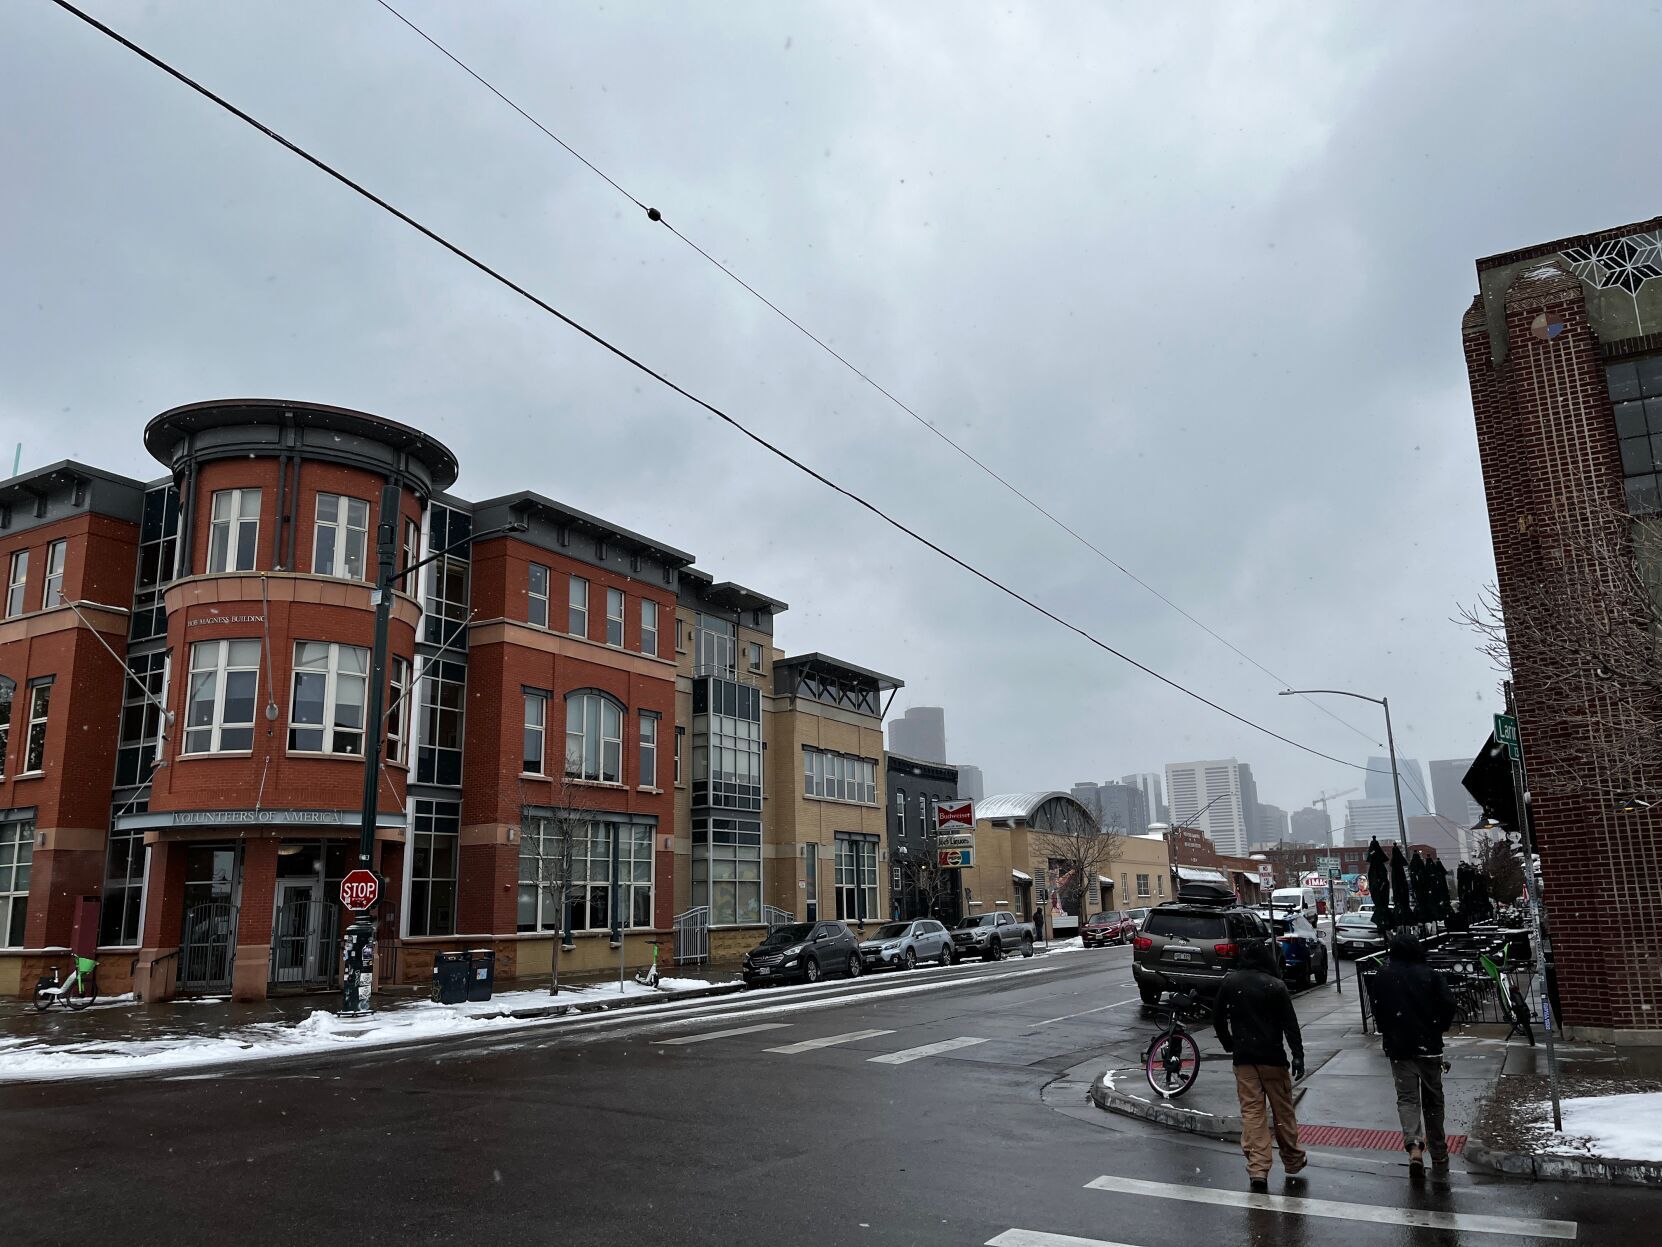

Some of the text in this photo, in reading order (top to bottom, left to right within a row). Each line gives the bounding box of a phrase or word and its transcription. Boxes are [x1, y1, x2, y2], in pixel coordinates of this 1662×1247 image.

[199, 616, 230, 625] MAGNESS
[231, 615, 265, 623] BUILDING
[174, 811, 340, 823] VOLUNTEERS OF AMERICA
[939, 812, 971, 820] Budweiser
[343, 882, 376, 898] STOP
